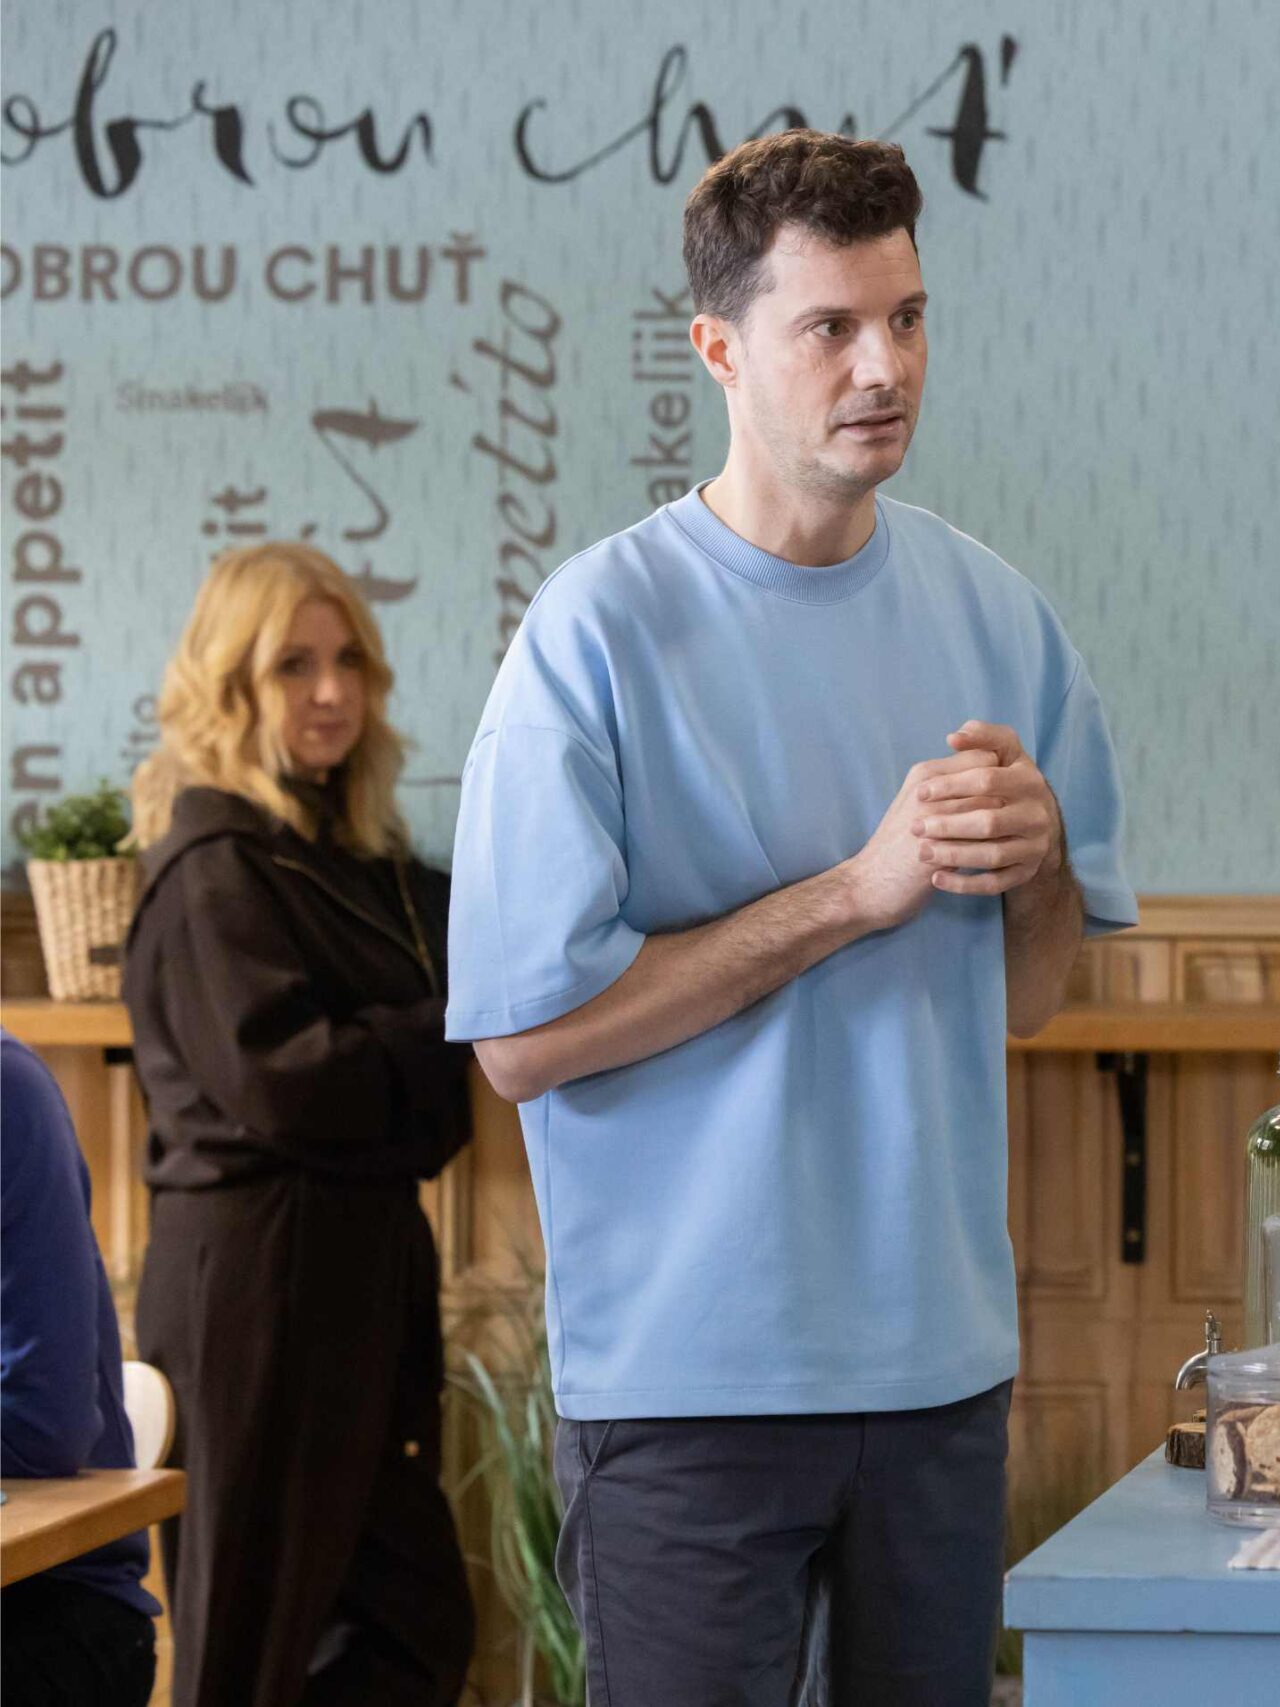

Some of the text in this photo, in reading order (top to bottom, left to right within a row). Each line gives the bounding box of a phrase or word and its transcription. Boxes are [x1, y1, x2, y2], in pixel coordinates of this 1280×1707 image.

[0, 27, 1019, 201] obrou chť
[265, 233, 485, 304] CHUŤ
